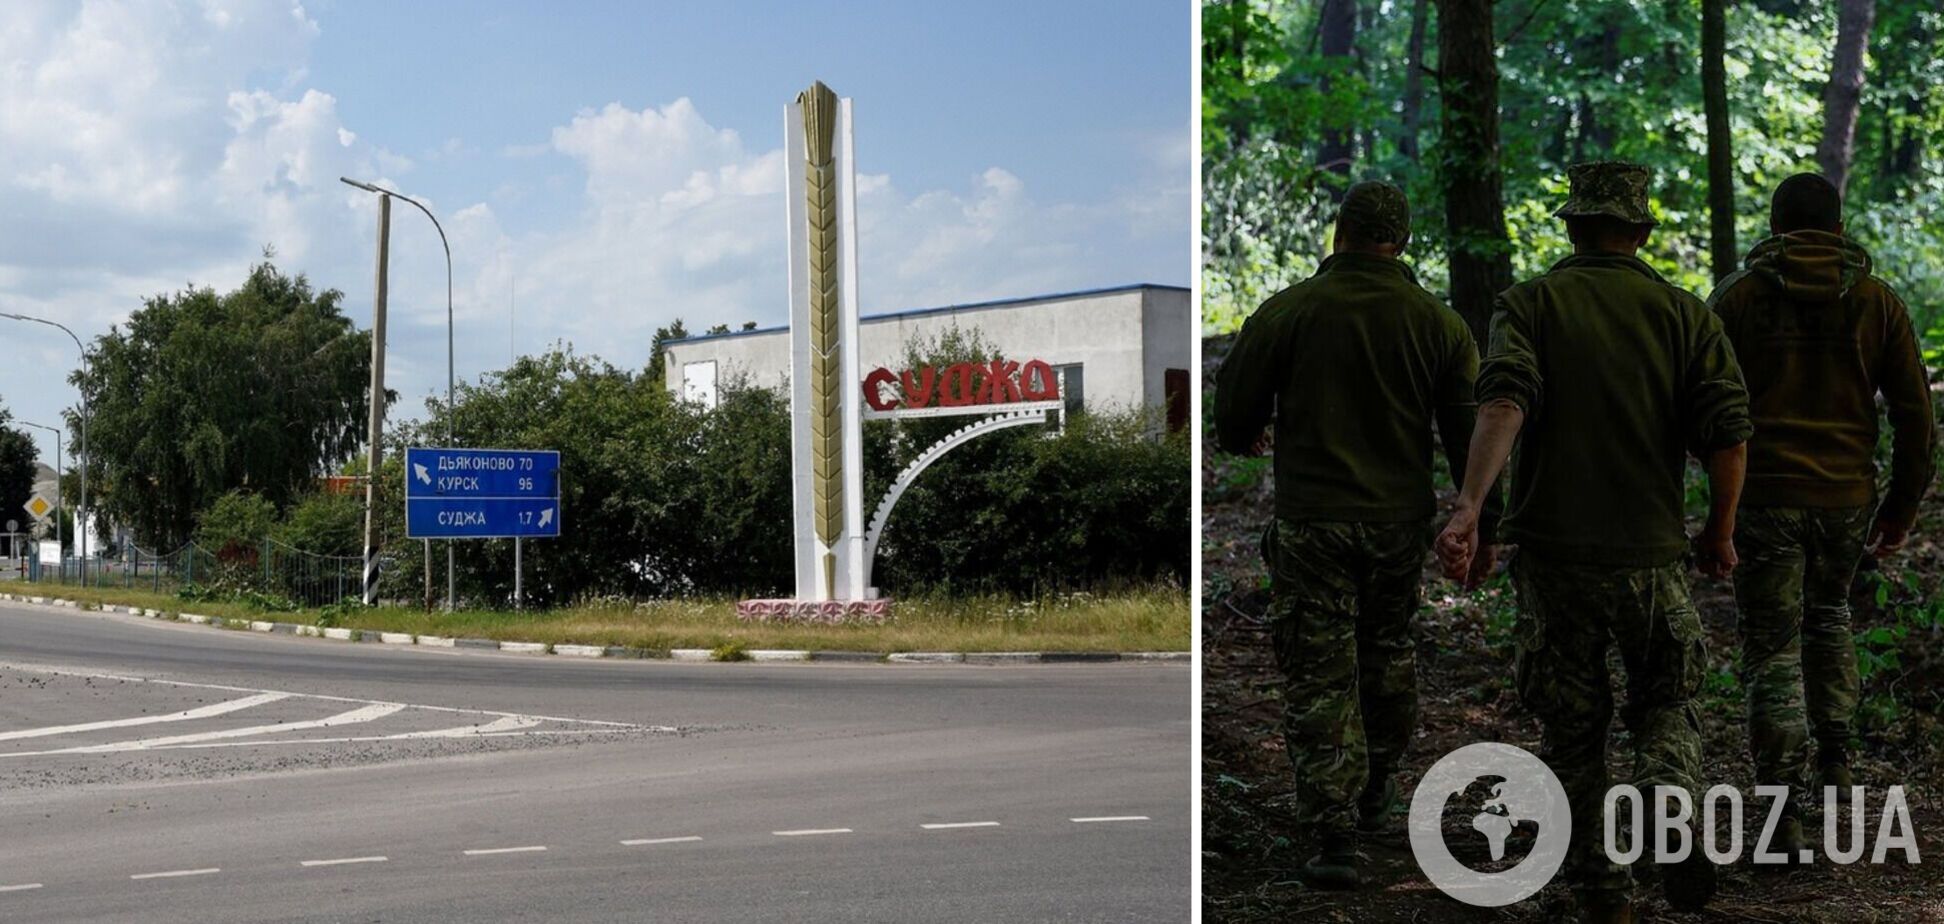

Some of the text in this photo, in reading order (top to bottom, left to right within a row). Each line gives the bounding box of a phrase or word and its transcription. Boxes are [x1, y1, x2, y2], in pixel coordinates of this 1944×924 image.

[862, 359, 1060, 411] СУДЖА
[438, 456, 533, 471] ДЬЯКОНОВО 70
[438, 477, 533, 490] КУРСК 96
[438, 511, 486, 526] СУДЖА
